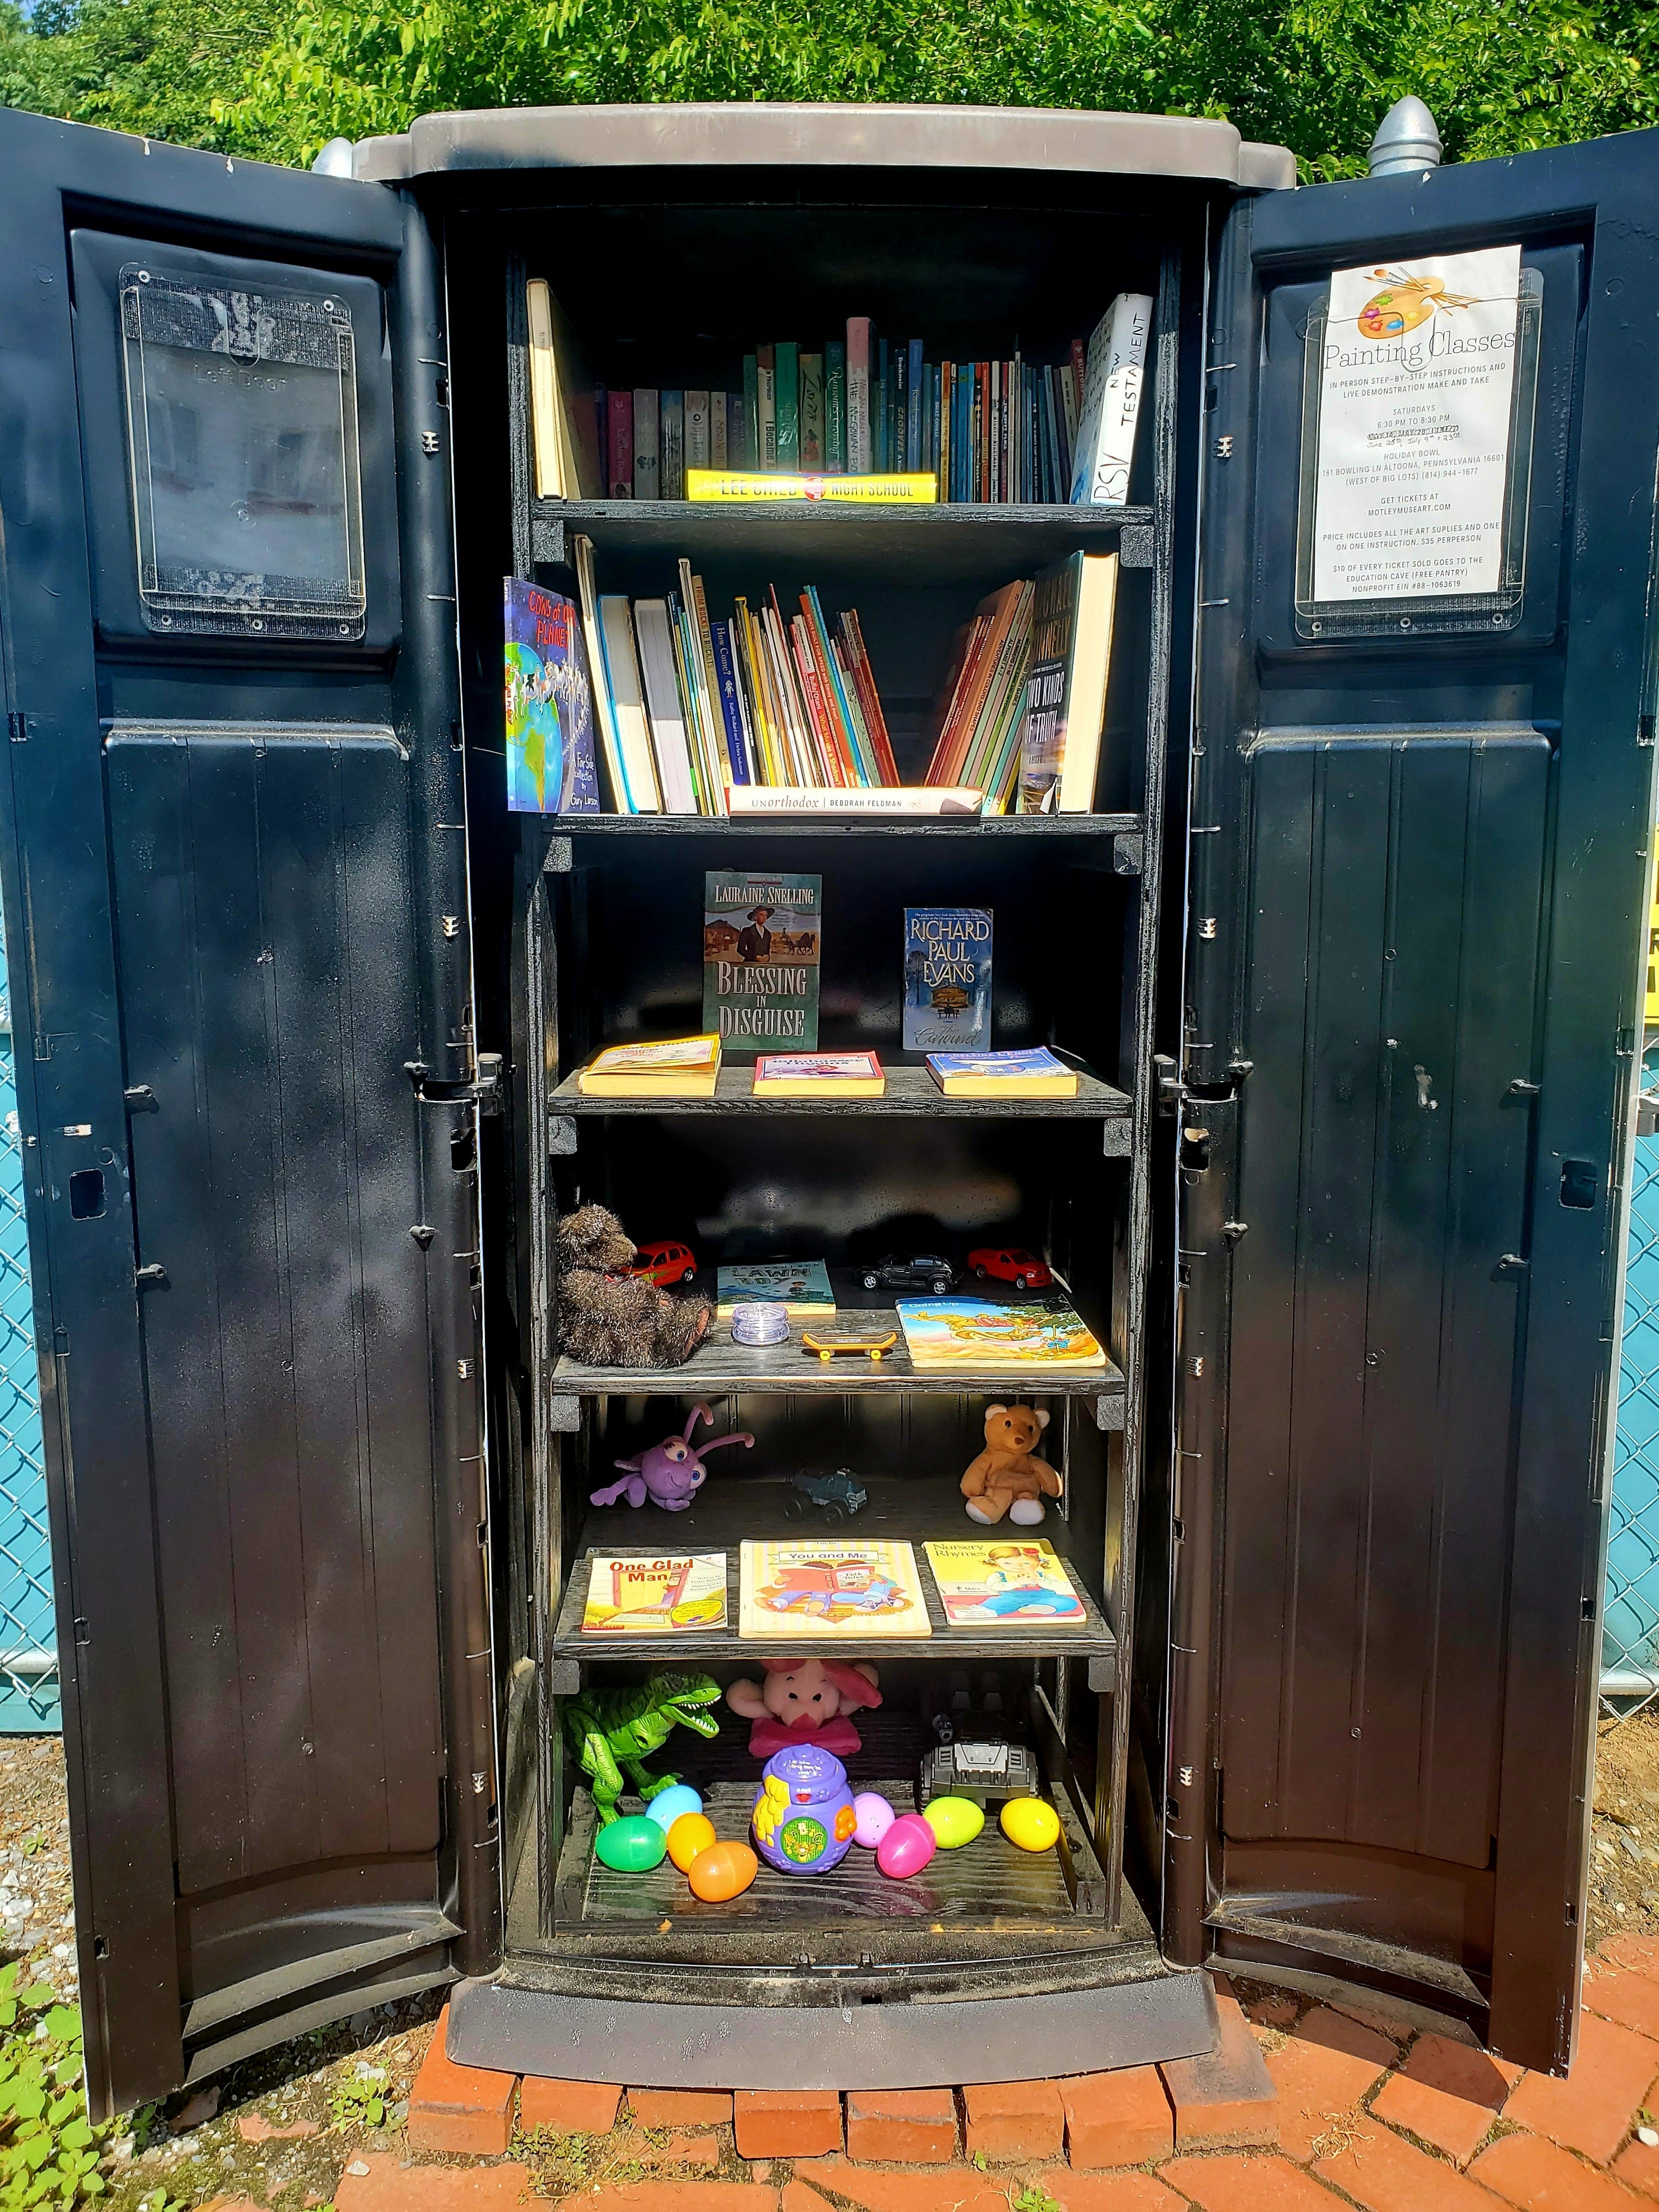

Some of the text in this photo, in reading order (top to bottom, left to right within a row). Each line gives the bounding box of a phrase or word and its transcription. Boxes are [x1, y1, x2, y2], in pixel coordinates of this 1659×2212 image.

[1323, 331, 1515, 369] Painting Classes
[1110, 352, 1121, 388] NEW
[1121, 312, 1146, 427] TESTAMENT
[1341, 379, 1368, 387] PERSON
[1372, 372, 1427, 384] STEP-BY-STEP
[1430, 366, 1486, 378] INSTRUCTIONS
[1362, 384, 1424, 396] DEMONSTRATION
[1393, 405, 1435, 415] SATURDAYS
[766, 426, 774, 460] Became
[1384, 451, 1415, 460] HOLIDAY
[1336, 466, 1369, 475] BOWLING
[1384, 462, 1420, 471] ALTOONA,
[1424, 457, 1480, 467] PENNSYLVANIA
[1094, 452, 1131, 502] RSV
[1346, 477, 1368, 485] (WEST
[1422, 471, 1440, 479] (814)
[1443, 468, 1478, 477] 944-1677
[722, 479, 748, 495] LEE
[753, 480, 797, 497] CHILD
[832, 481, 865, 496] NIGHT
[869, 482, 914, 497] SCHOOL
[1368, 504, 1451, 516] MOTLEYMUSEART.COM
[1347, 531, 1382, 539] INCLUDES
[1433, 525, 1462, 533] SUPLIES
[1367, 539, 1419, 548] INSTRUCTION.
[1438, 535, 1481, 544] PERPERSON
[1347, 574, 1387, 582] EDUCATION
[1353, 584, 1394, 593] NONPROFIT
[1412, 581, 1460, 589] #88-1063619
[695, 586, 705, 605] FROM
[528, 590, 576, 627] COWS of OUR
[698, 607, 708, 629] ROCKS
[537, 619, 570, 650] PLANET
[703, 640, 714, 669] ROCKETS
[715, 627, 731, 676] How Come?
[991, 639, 1004, 673] ADVENTURES
[1001, 638, 1013, 665] ALPHABET
[1009, 639, 1022, 664] NUMBERS
[817, 656, 825, 672] SPEED
[822, 683, 831, 698] Davey
[808, 675, 821, 710] Bulla/Otani
[980, 679, 991, 699] COLORS
[1027, 670, 1065, 709] TWO KINDS
[970, 712, 980, 732] SHAPES
[1024, 709, 1058, 744] OF TRUTH
[818, 714, 827, 732] What
[823, 732, 832, 752] Makes
[828, 758, 841, 785] Shadow?
[571, 752, 595, 770] A Far Side
[736, 756, 744, 775] Solomon
[575, 770, 593, 784] collection
[570, 791, 598, 810] Gary Larson
[751, 795, 820, 809] UNorthodox
[830, 799, 865, 807] DEBORAH
[715, 885, 815, 904] LAURAINE SNELLING
[910, 919, 990, 943] RICHARD
[928, 941, 970, 961] PAUL
[717, 961, 807, 995] BLESSING
[923, 962, 975, 987] EVANS
[756, 995, 767, 1008] IN
[719, 1006, 805, 1038] DISGUISE
[914, 1028, 981, 1046] Carousel
[732, 1268, 812, 1277] LAWN
[610, 1559, 693, 1571] One Glad
[628, 1572, 668, 1582] Man
